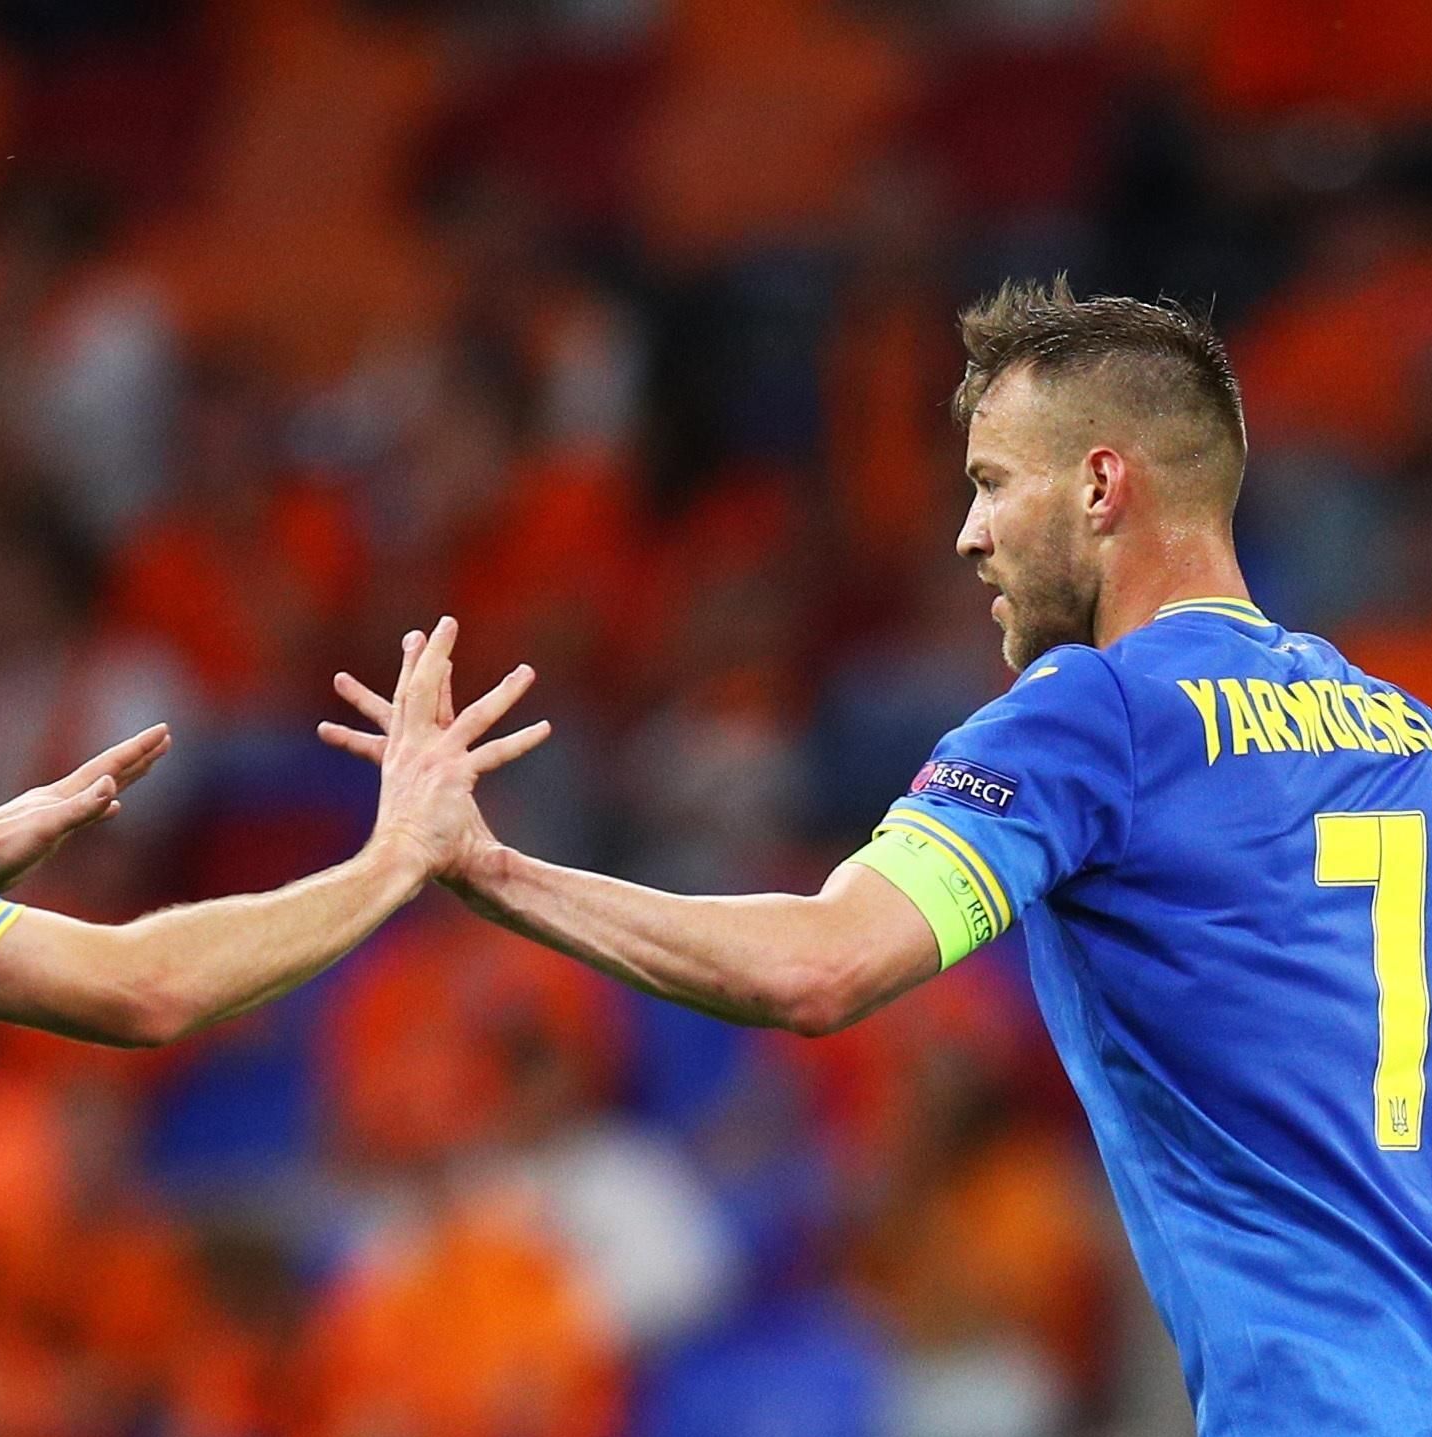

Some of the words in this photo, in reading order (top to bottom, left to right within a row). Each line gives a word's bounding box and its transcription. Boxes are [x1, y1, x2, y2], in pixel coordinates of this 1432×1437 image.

[928, 767, 1014, 807] RESPECT
[967, 899, 992, 943] RES
[1314, 810, 1430, 1151] 7
